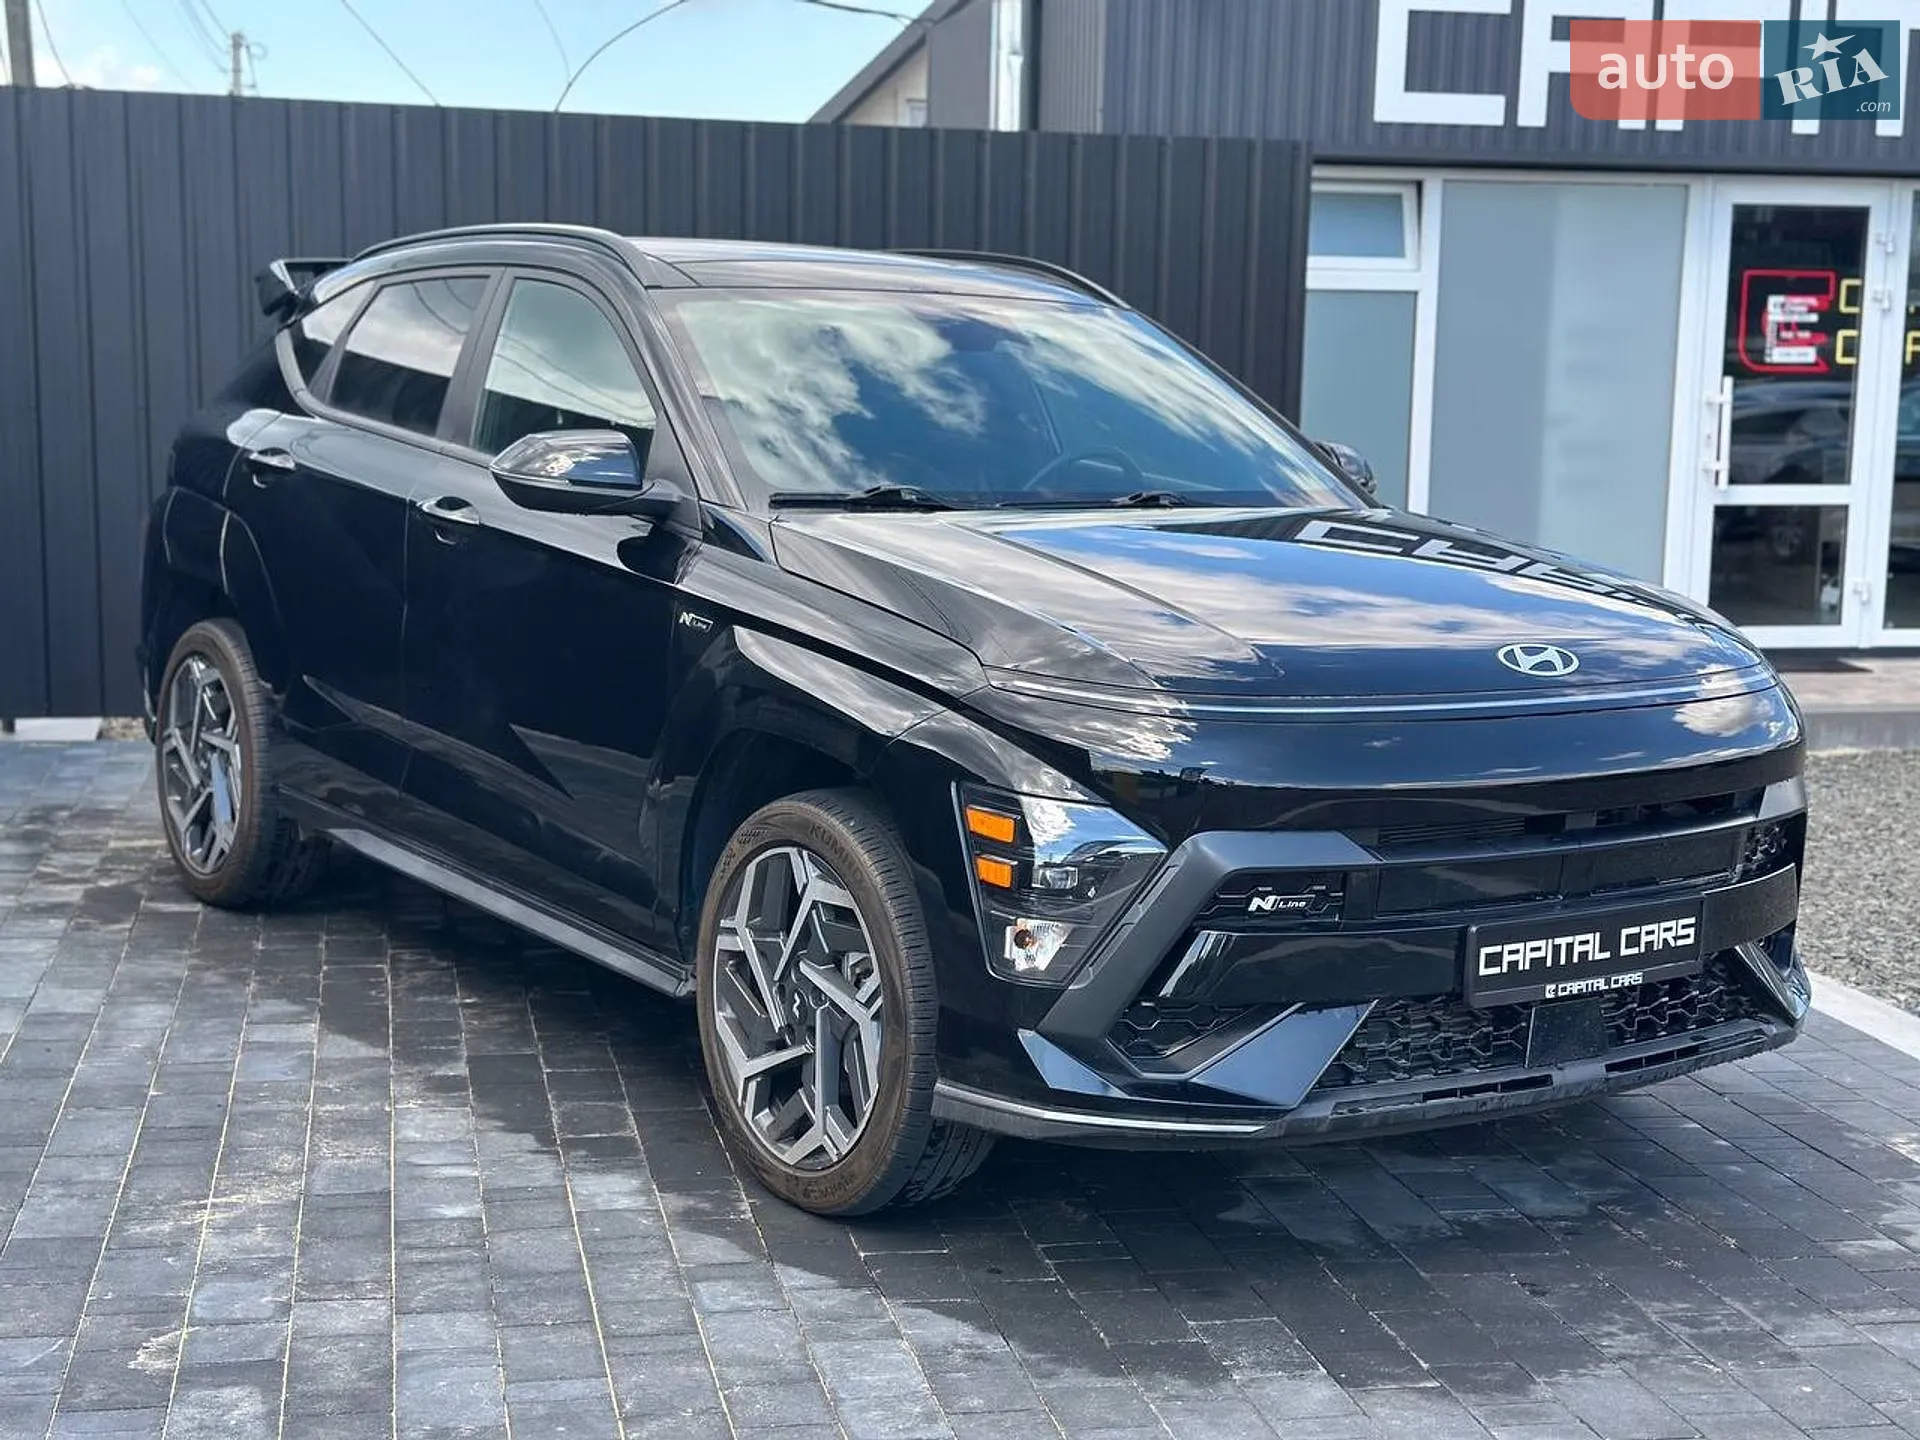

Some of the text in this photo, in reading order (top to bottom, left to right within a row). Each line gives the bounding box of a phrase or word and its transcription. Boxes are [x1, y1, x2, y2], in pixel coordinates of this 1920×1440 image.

[1247, 895, 1280, 912] N
[1478, 916, 1696, 977] CAPITAL CARS
[1558, 972, 1644, 997] CAPITAL CARS
